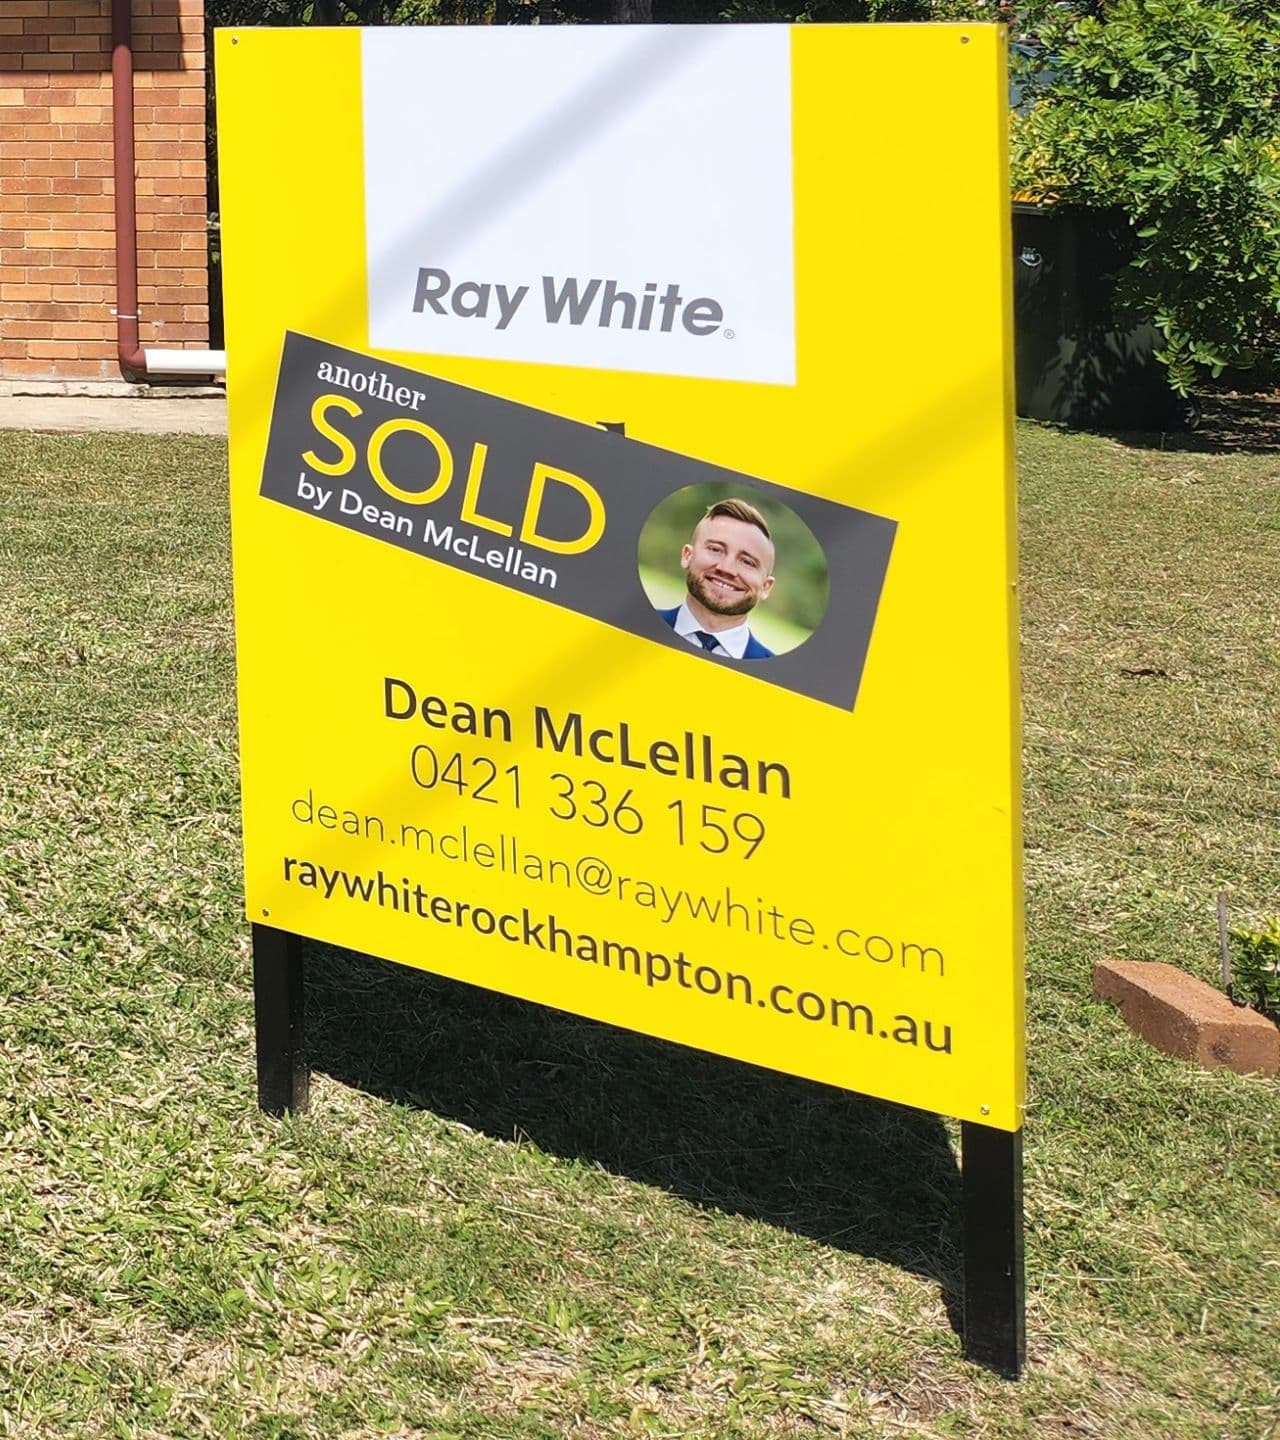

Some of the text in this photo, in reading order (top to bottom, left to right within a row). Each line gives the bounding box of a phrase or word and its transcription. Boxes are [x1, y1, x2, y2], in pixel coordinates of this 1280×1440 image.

[412, 267, 724, 337] Ray White
[317, 360, 427, 411] another
[297, 472, 558, 588] by Dean McLellan
[301, 394, 607, 555] SOLD
[383, 676, 792, 800] Dean McLellan
[410, 744, 766, 860] 0421 336 159
[291, 788, 945, 977] dean.mclellan@raywhite.com
[283, 856, 953, 1055] raywhiterockhampton.com.au
